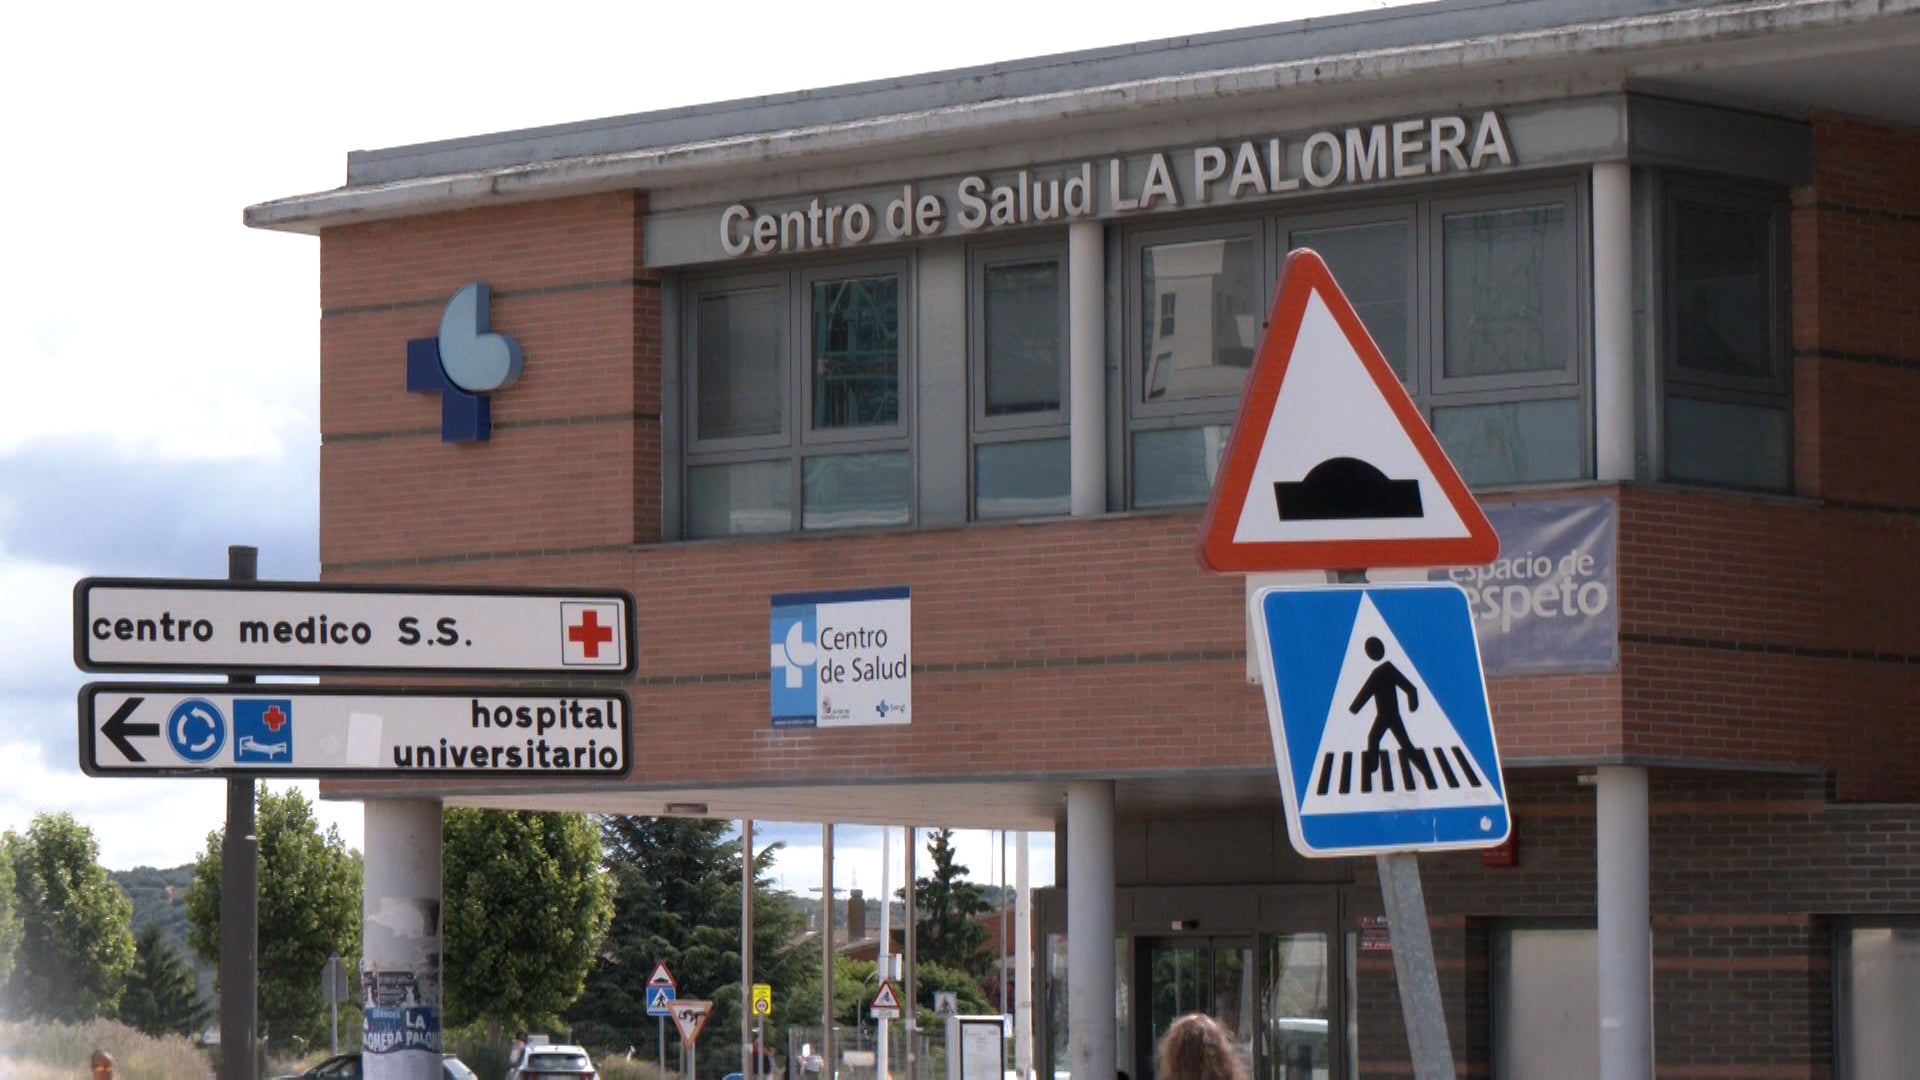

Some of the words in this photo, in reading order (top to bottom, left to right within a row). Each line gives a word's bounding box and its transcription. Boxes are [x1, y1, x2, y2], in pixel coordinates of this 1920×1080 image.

[720, 197, 874, 256] Centro
[886, 184, 945, 237] de
[957, 162, 1095, 230] Salud
[1110, 153, 1181, 211] LA
[1195, 110, 1515, 202] PALOMERA
[1558, 549, 1594, 577] de
[1466, 575, 1609, 633] espeto
[92, 612, 214, 642] centro
[239, 615, 372, 645] medico
[398, 617, 473, 647] S.S.
[820, 627, 888, 650] Centro
[820, 657, 845, 684] de
[852, 653, 907, 683] Salud
[472, 698, 618, 736] hospital
[393, 737, 618, 769] universitario
[406, 1010, 426, 1031] LA
